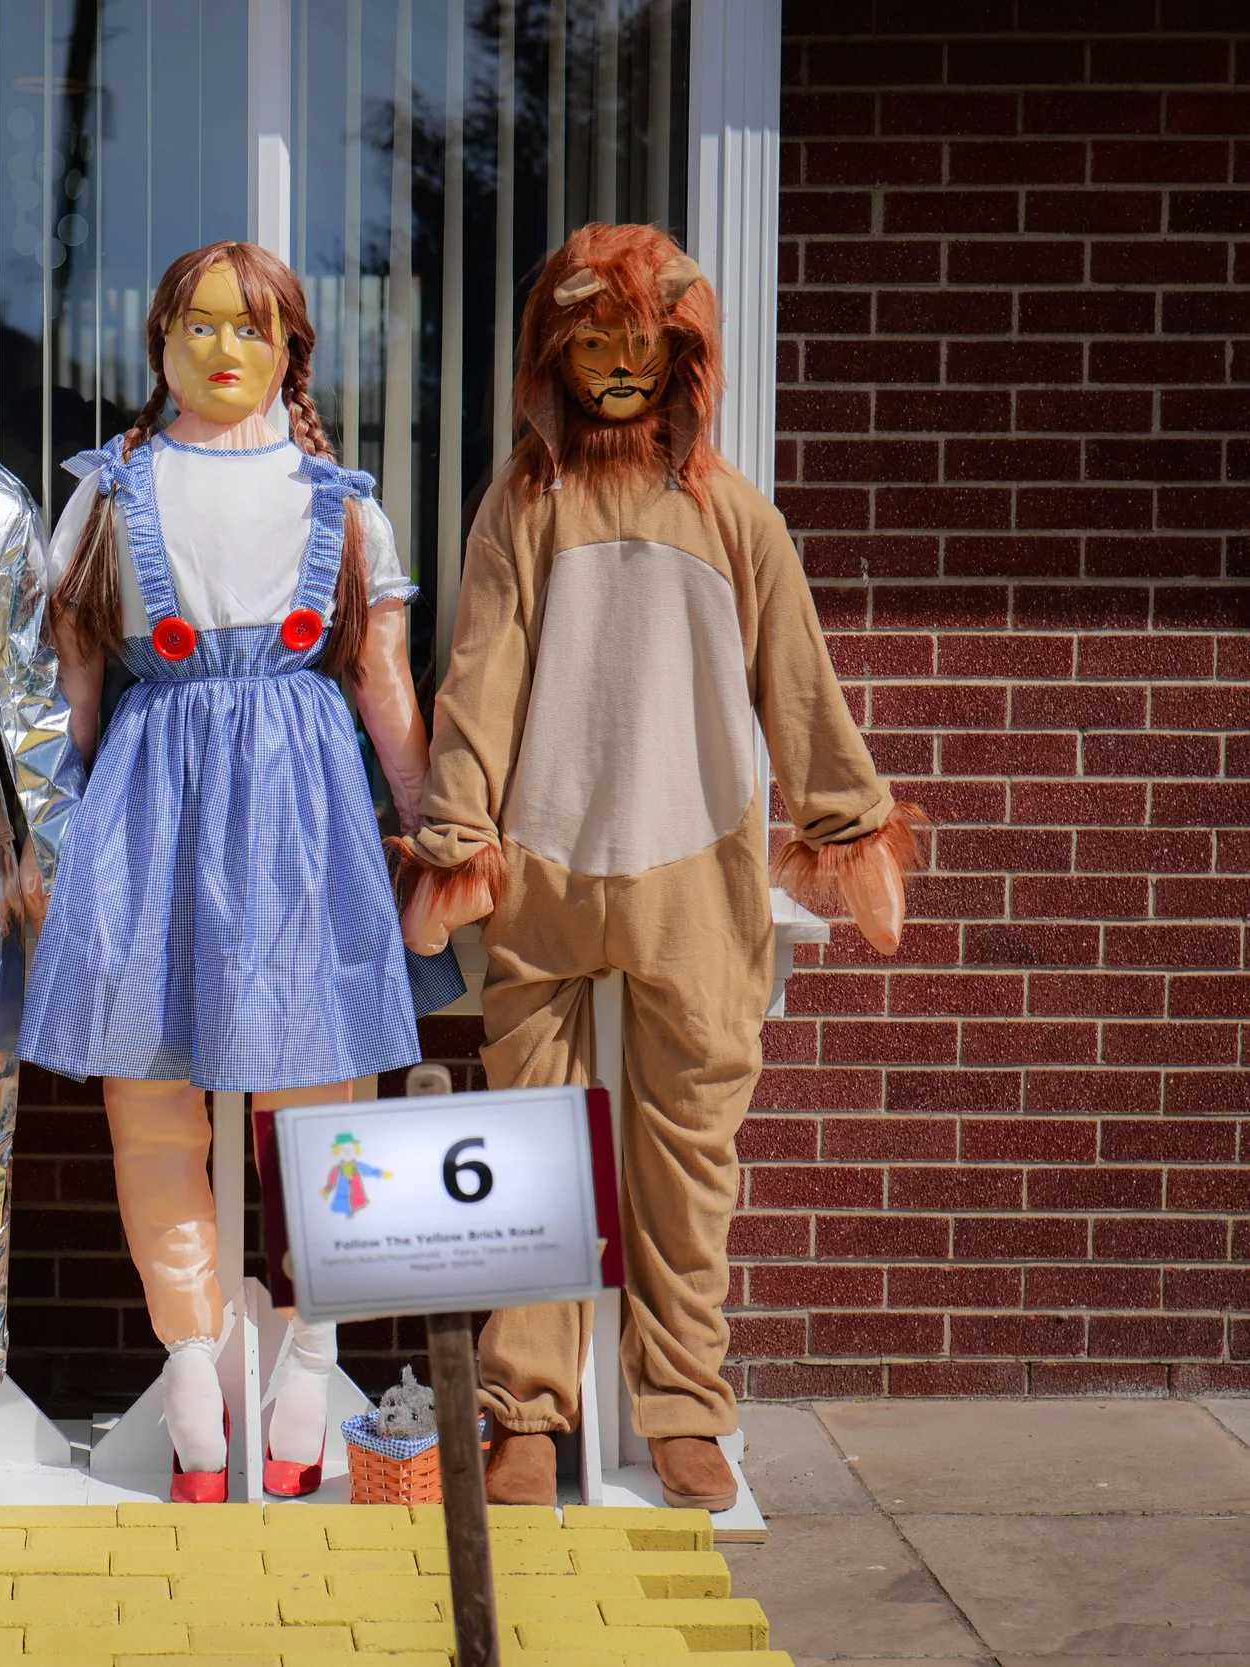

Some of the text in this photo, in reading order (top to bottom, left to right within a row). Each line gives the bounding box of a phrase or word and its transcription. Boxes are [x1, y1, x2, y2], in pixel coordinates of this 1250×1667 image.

[442, 1137, 494, 1203] 6
[334, 1225, 545, 1251] Follow The Yellow Brick Road
